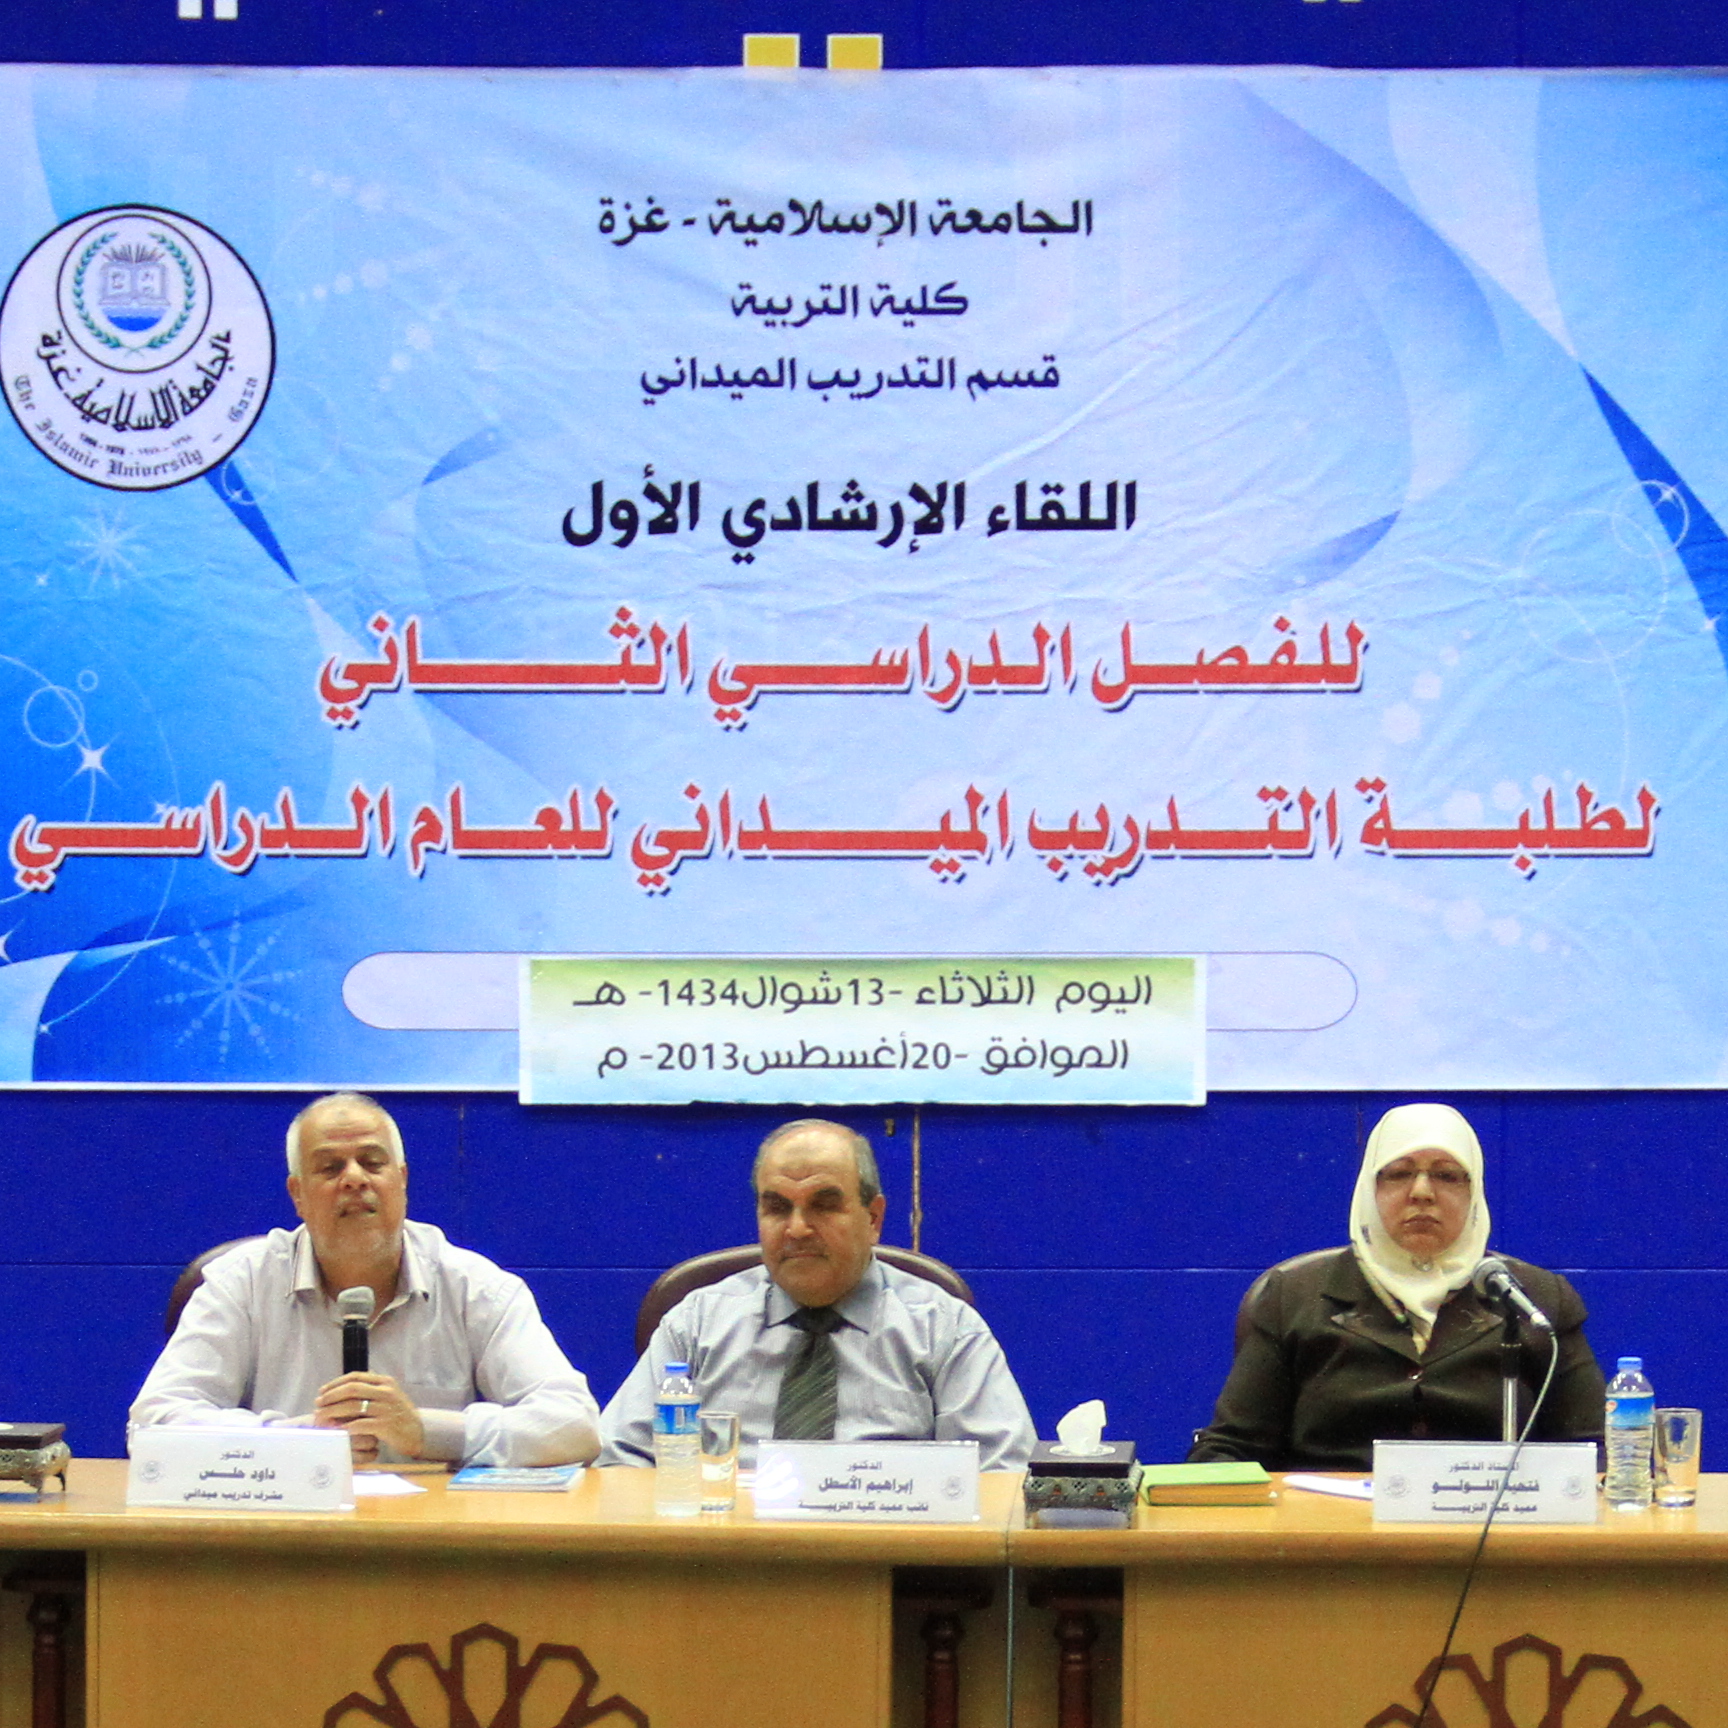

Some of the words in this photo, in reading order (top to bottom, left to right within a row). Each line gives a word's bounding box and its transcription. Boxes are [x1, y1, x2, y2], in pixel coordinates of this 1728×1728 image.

[597, 196, 670, 247] غزة
[708, 198, 917, 248] الإسلامية
[929, 198, 1094, 248] الجامعة
[731, 283, 859, 328] التربية
[869, 281, 969, 327] كلية
[640, 357, 796, 406] الميداني
[807, 356, 956, 402] التدريب
[966, 355, 1060, 400] قسم
[35, 418, 101, 471] Islamic
[105, 449, 204, 479] University
[561, 463, 701, 549] الأول
[721, 479, 967, 566] الإرشادي
[986, 480, 1138, 538] اللقاء
[319, 606, 692, 724] الثاني
[707, 622, 1075, 724] الدراسي
[1090, 616, 1368, 708] للفصل
[13, 788, 393, 886] الدراسي
[409, 789, 614, 870] للعام
[630, 783, 1010, 888] الميداني
[1028, 786, 1339, 879] التدريب
[1355, 777, 1660, 873] لطلبة
[915, 970, 1036, 1008] الثلاثاء
[1055, 974, 1153, 1014] اليوم
[597, 1047, 628, 1080] م
[980, 1037, 1129, 1078] الموافق
[250, 1466, 276, 1482] داود
